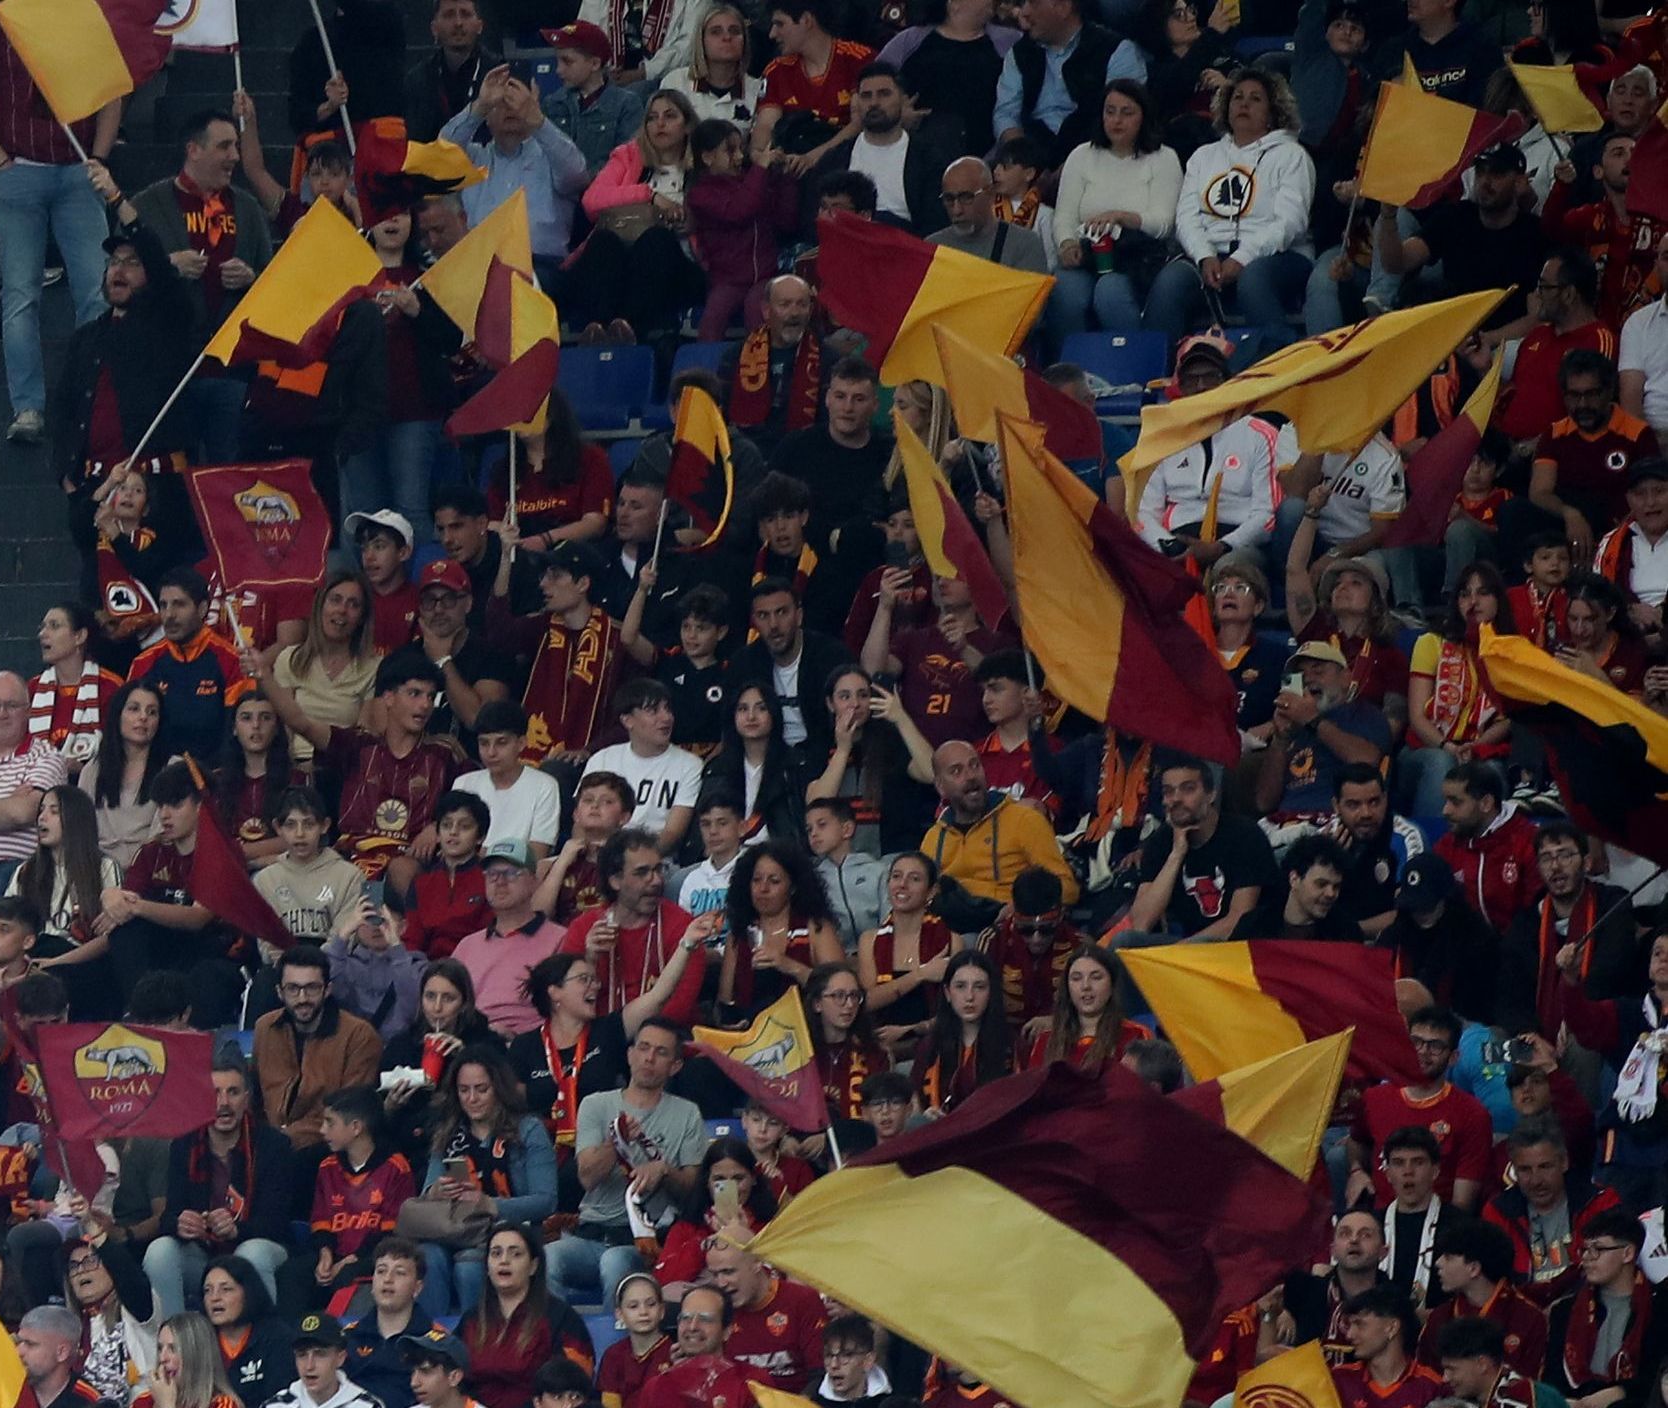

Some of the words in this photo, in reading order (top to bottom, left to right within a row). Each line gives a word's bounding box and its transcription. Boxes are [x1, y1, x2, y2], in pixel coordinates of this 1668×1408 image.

[517, 497, 569, 514] italbits
[926, 693, 952, 715] 21
[90, 1080, 152, 1101] ROMA
